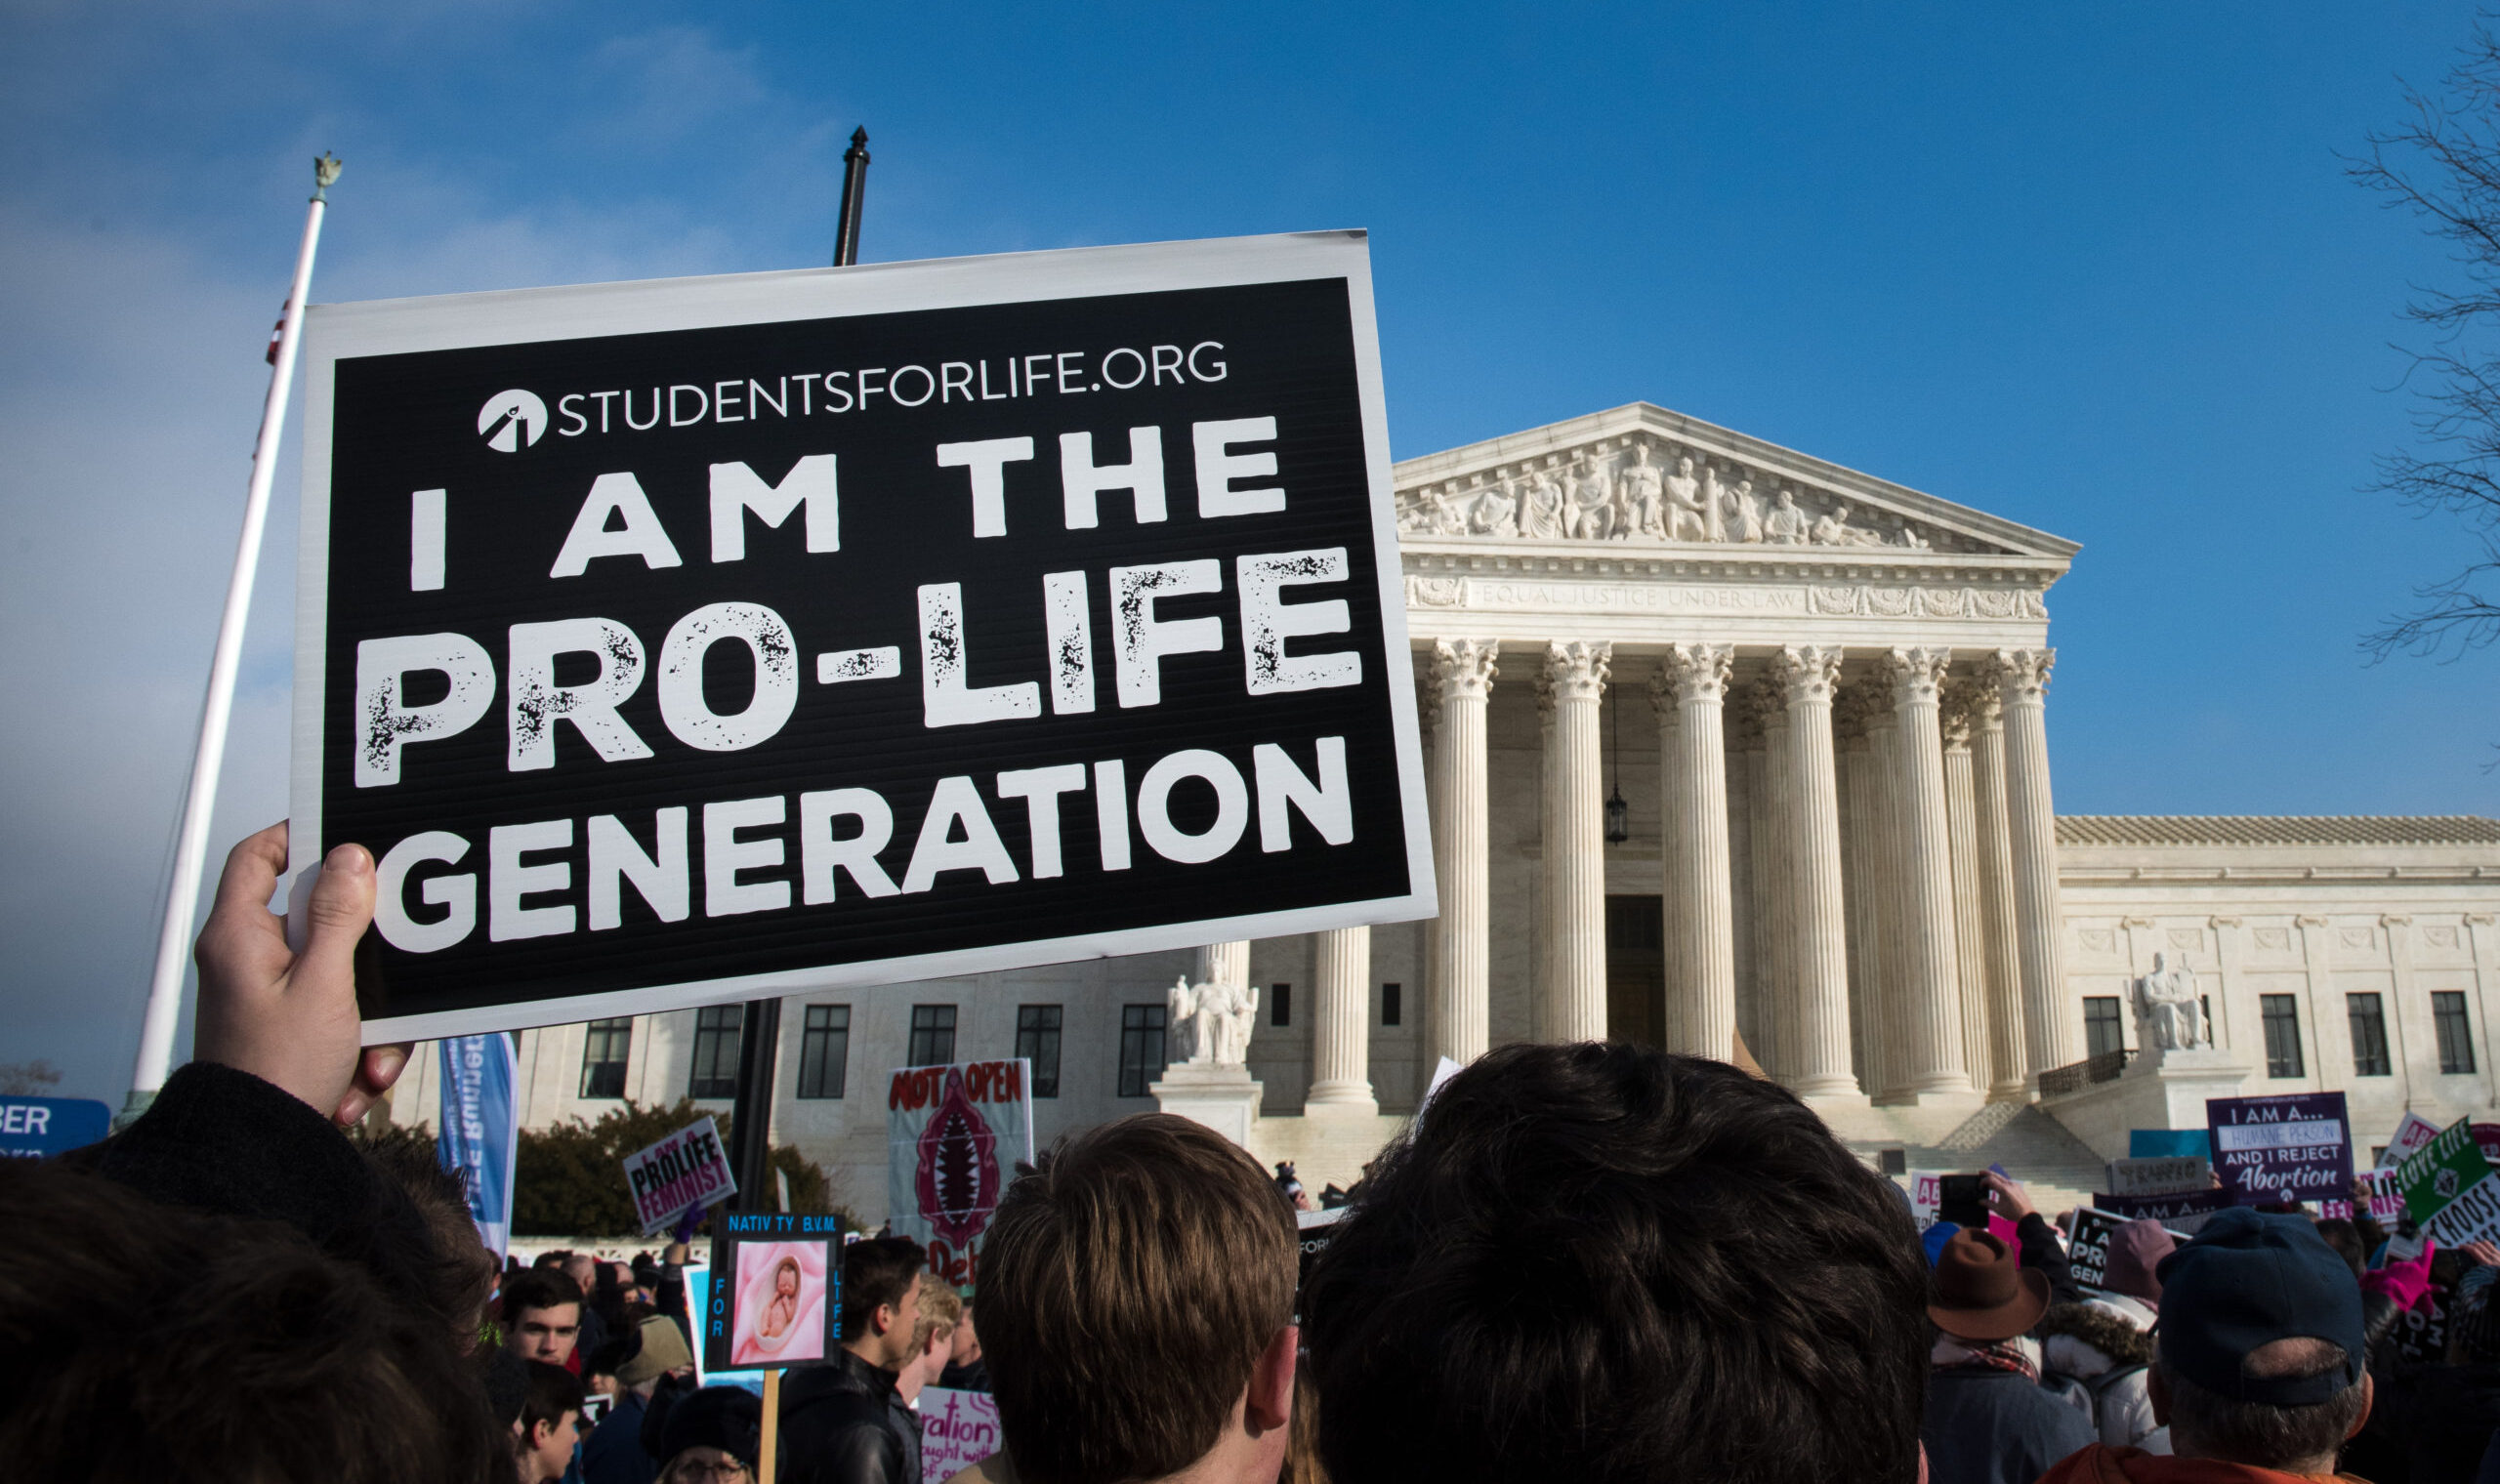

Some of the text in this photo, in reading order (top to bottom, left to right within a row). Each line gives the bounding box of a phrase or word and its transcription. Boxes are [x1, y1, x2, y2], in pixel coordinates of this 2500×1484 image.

[558, 341, 1228, 436] STUDENTSFORLIFE.ORG
[410, 415, 1286, 592] I AM THE
[1483, 586, 1794, 607] EQUAL JUSTICE UNDER LAW
[354, 546, 1362, 788] PRO-LIFE
[372, 735, 1354, 954] GENERATION
[889, 1061, 1021, 1111] NOT OPEN
[2230, 1109, 2237, 1124] I
[2246, 1106, 2280, 1123] AM
[2226, 1145, 2339, 1166] AND I REJECT
[2289, 1124, 2334, 1143] PERSON
[2400, 1119, 2471, 1191] LOVE LIFE
[631, 1132, 718, 1198] PROLIFE
[638, 1154, 727, 1222] FEMINIST
[2236, 1163, 2338, 1192] Abortion
[2071, 1242, 2107, 1267] PR
